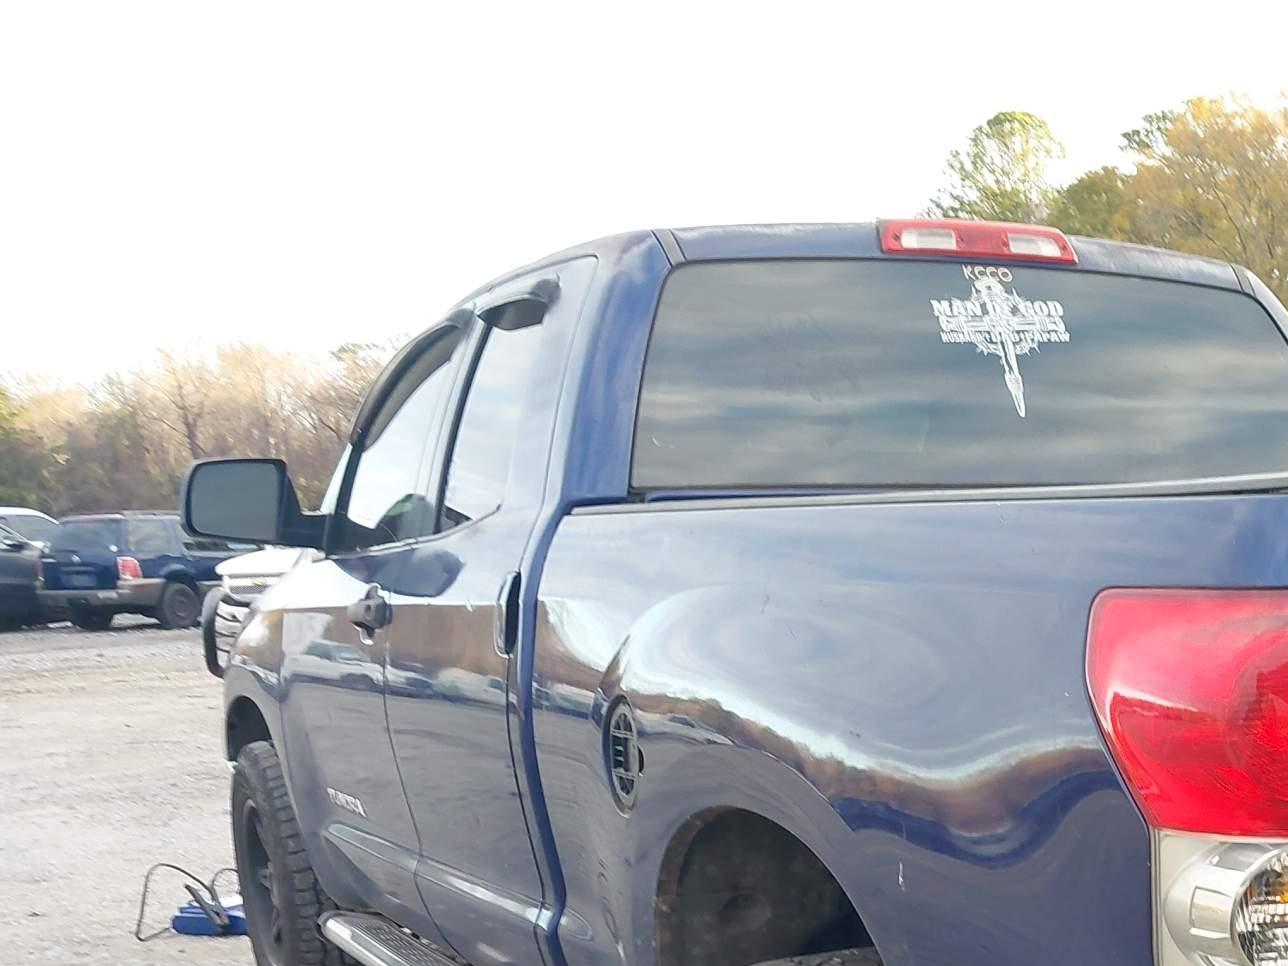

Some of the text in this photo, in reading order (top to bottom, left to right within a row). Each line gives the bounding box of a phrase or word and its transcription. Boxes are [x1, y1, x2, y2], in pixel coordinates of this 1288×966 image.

[962, 264, 1013, 282] KCCO
[930, 299, 982, 317] MAN
[1021, 300, 1064, 317] GOD
